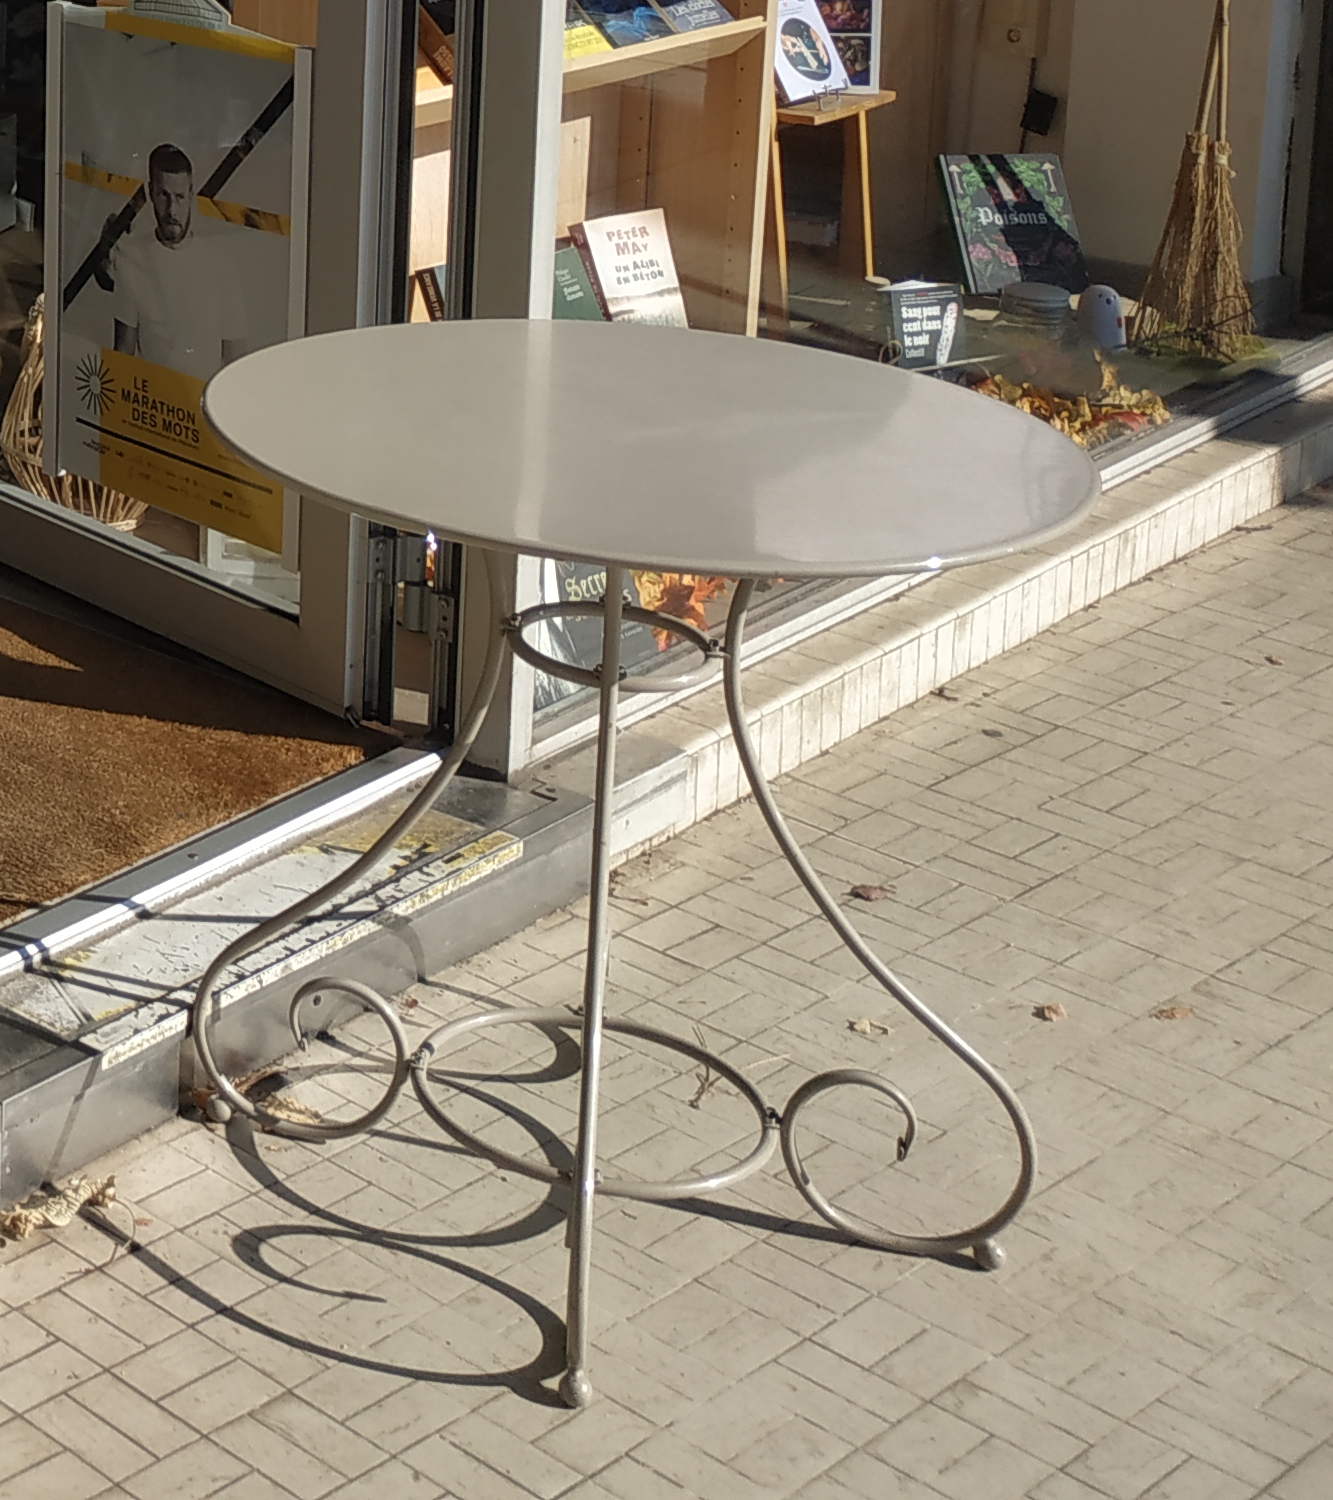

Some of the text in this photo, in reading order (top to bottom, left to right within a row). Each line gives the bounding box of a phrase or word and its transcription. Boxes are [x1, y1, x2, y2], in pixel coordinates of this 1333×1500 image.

[975, 206, 1048, 225] Poisons
[606, 225, 649, 242] PETER
[614, 241, 648, 256] MAY
[614, 259, 659, 273] UN ALIBI
[616, 276, 631, 285] EN
[901, 305, 941, 320] Sang pour
[903, 320, 941, 332] cent dans
[904, 333, 930, 347] le noir
[133, 376, 148, 393] LE
[121, 388, 196, 426] MARATHON
[132, 407, 157, 433] DES
[162, 420, 200, 444] MOTS
